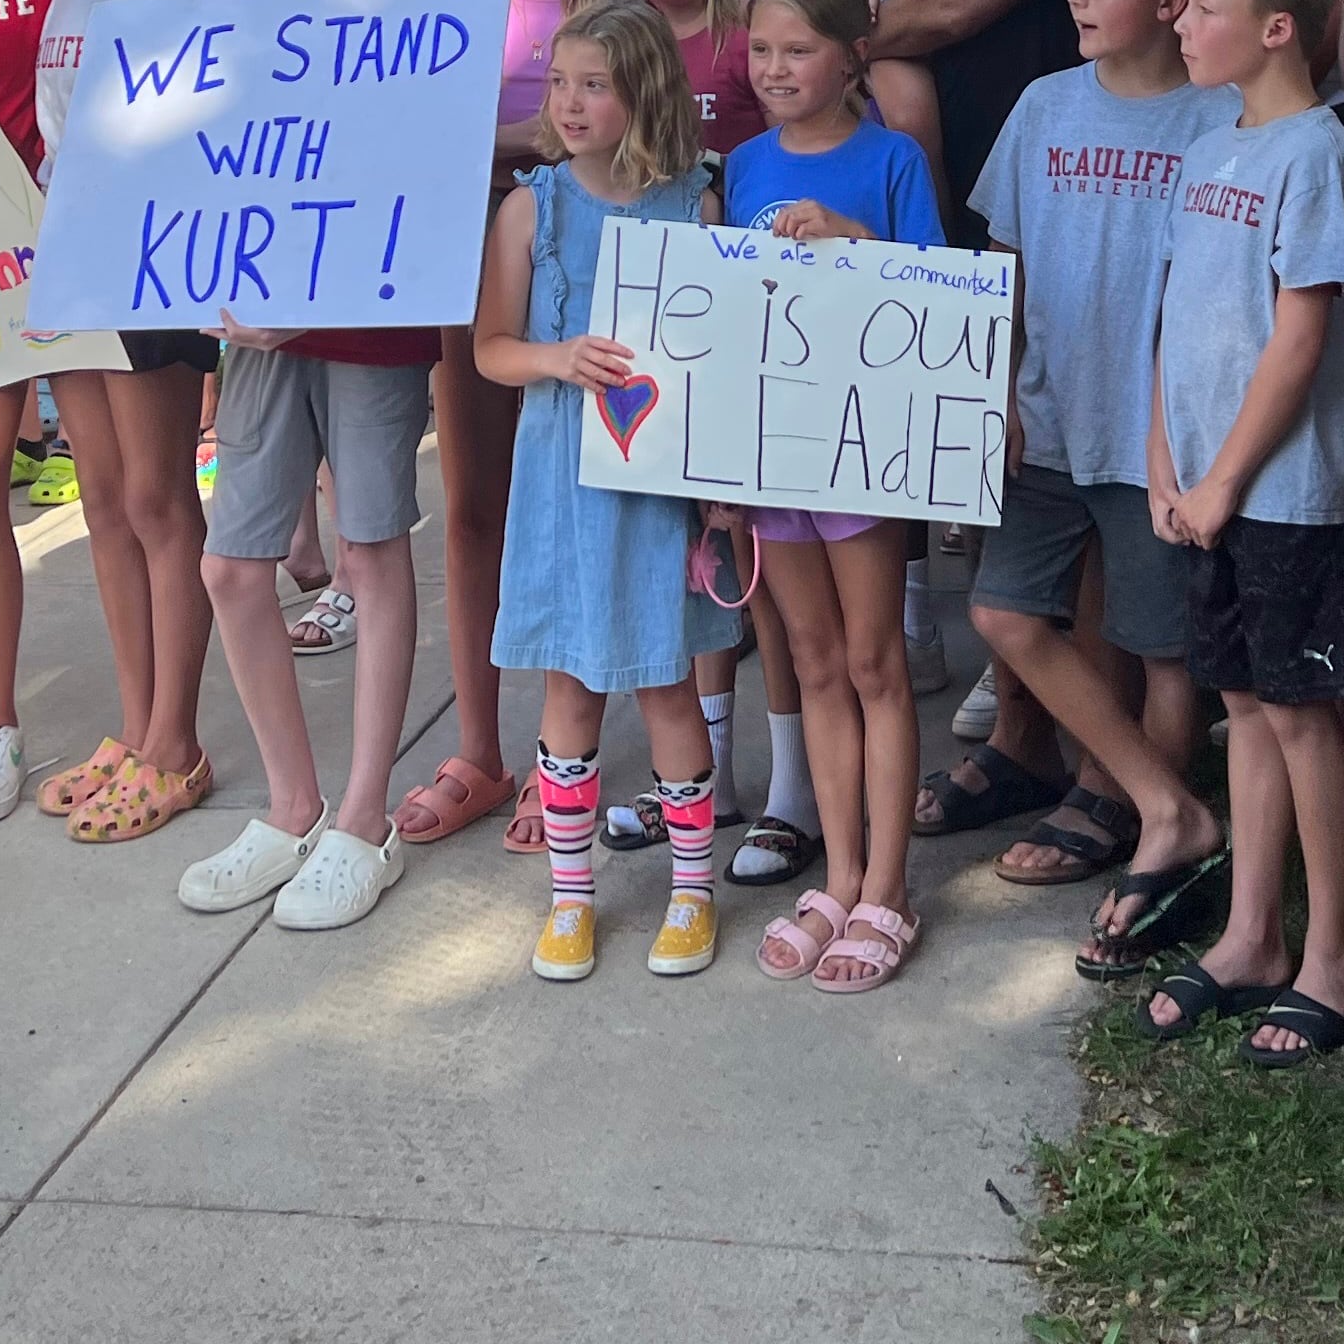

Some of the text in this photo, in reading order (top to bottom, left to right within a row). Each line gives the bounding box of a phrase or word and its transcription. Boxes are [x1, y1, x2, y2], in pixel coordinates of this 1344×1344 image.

[114, 12, 470, 106] WE STAND
[196, 115, 331, 184] WITH
[1046, 146, 1183, 185] McAULIFF
[1052, 179, 1170, 201] ATHLETIC
[711, 231, 760, 260] We
[779, 241, 817, 266] are
[835, 256, 858, 271] a
[611, 226, 1011, 380] He is our
